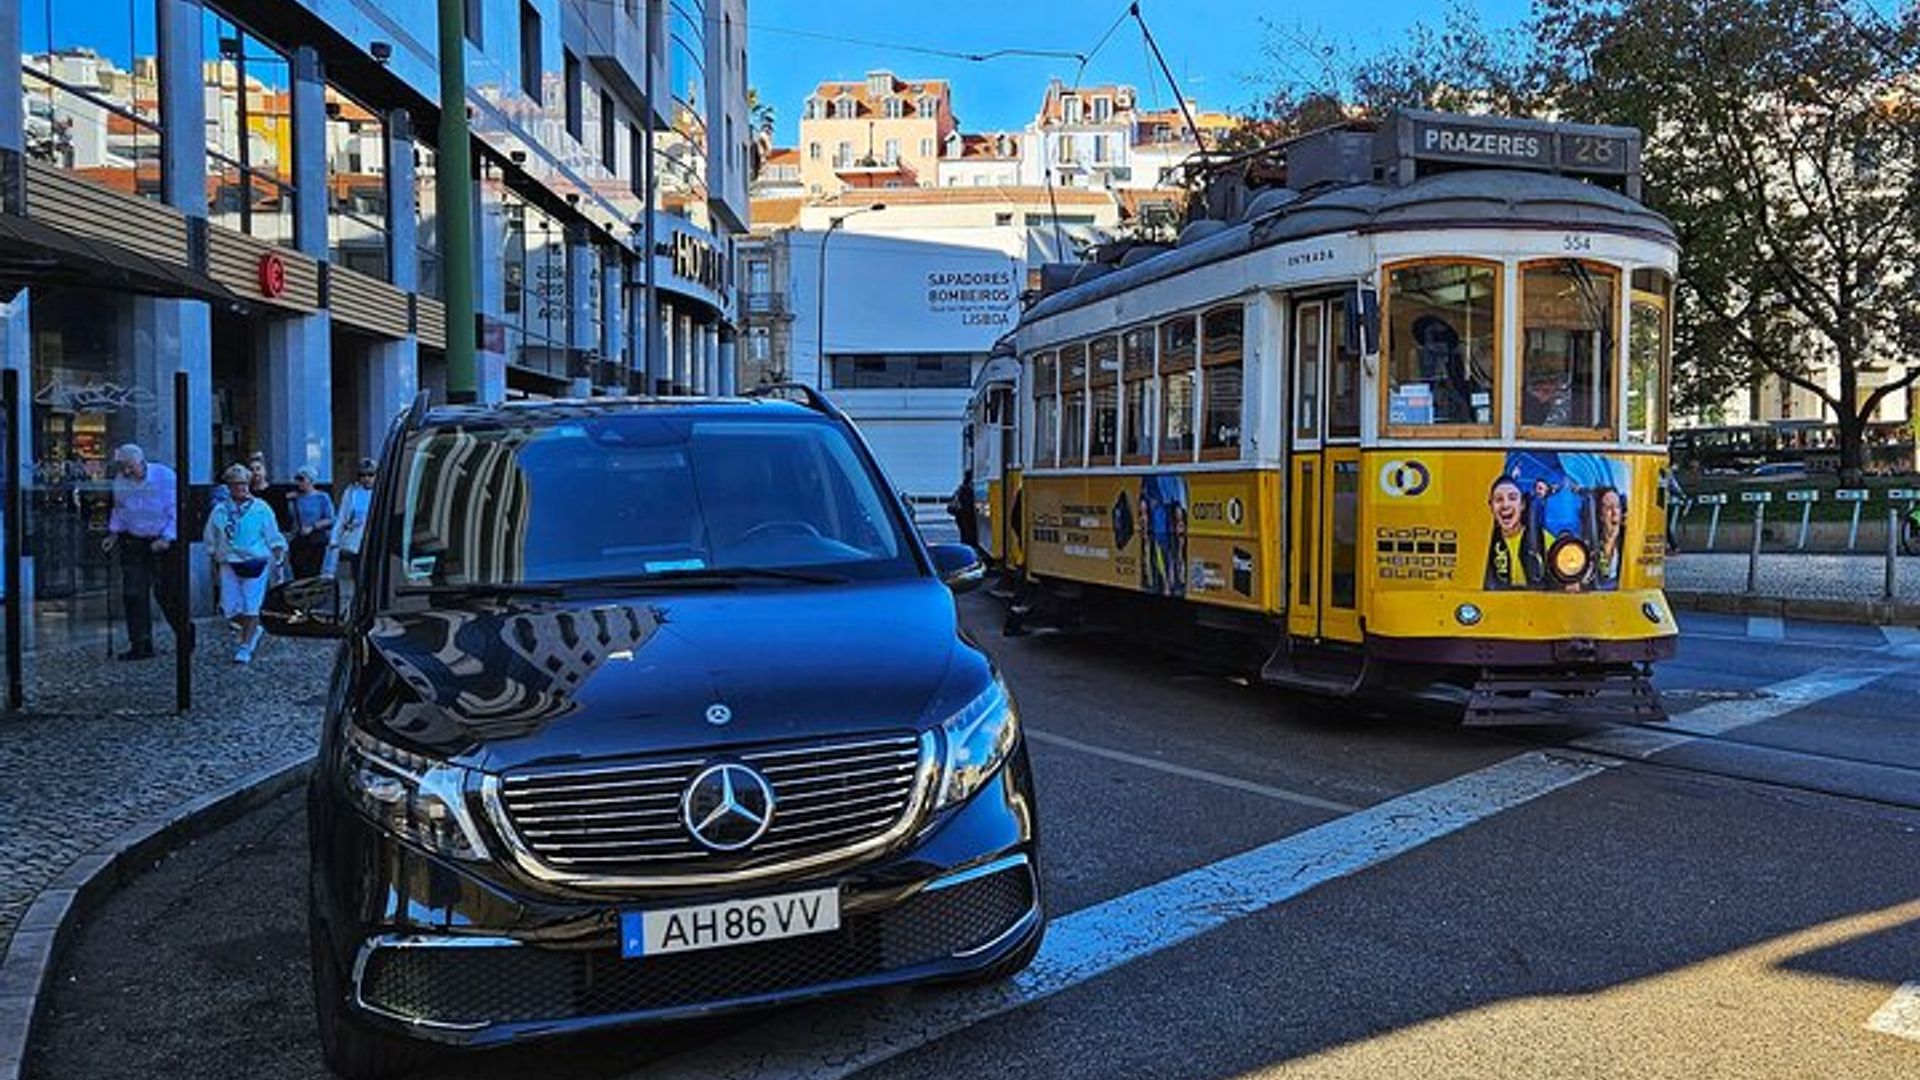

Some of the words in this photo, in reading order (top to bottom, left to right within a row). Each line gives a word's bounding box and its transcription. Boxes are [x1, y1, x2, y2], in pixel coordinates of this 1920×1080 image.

[1426, 129, 1539, 156] PRAZERES
[1576, 137, 1613, 162] 28
[1563, 235, 1591, 251] 554
[928, 272, 1010, 287] SAPADORES
[928, 289, 1010, 304] BOMBEIROS
[962, 312, 1010, 326] LISBOA
[1376, 526, 1457, 540] GoPro
[1376, 555, 1457, 568] HERO12
[1379, 568, 1454, 580] BLACK
[661, 911, 718, 948] AH
[725, 906, 766, 939] 86
[773, 897, 821, 933] VV
